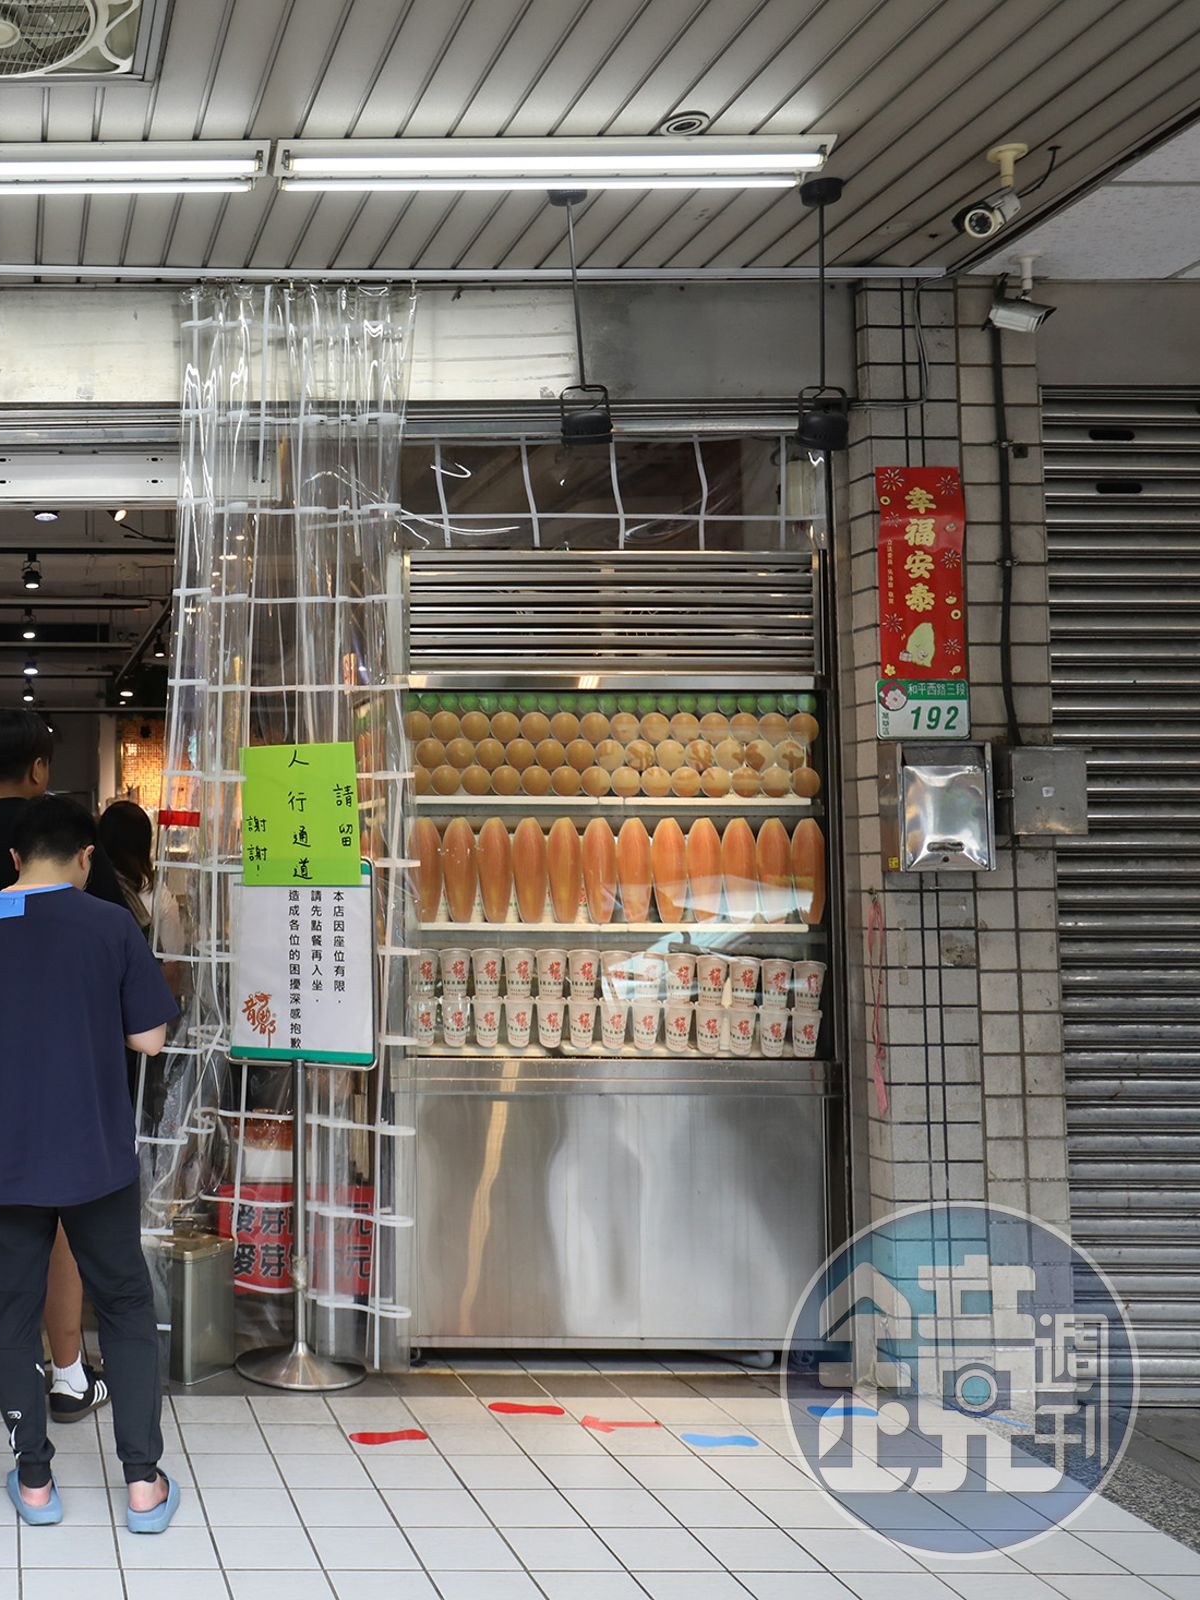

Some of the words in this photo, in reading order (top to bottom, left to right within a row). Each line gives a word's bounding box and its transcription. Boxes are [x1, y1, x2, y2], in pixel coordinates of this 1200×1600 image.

[904, 486, 936, 612] 幸福安泰
[908, 683, 965, 696] 和平西路三段
[911, 706, 959, 730] 192
[288, 750, 313, 880] 人行通道
[288, 890, 302, 1048] 造成各位的困擾深感抱歉
